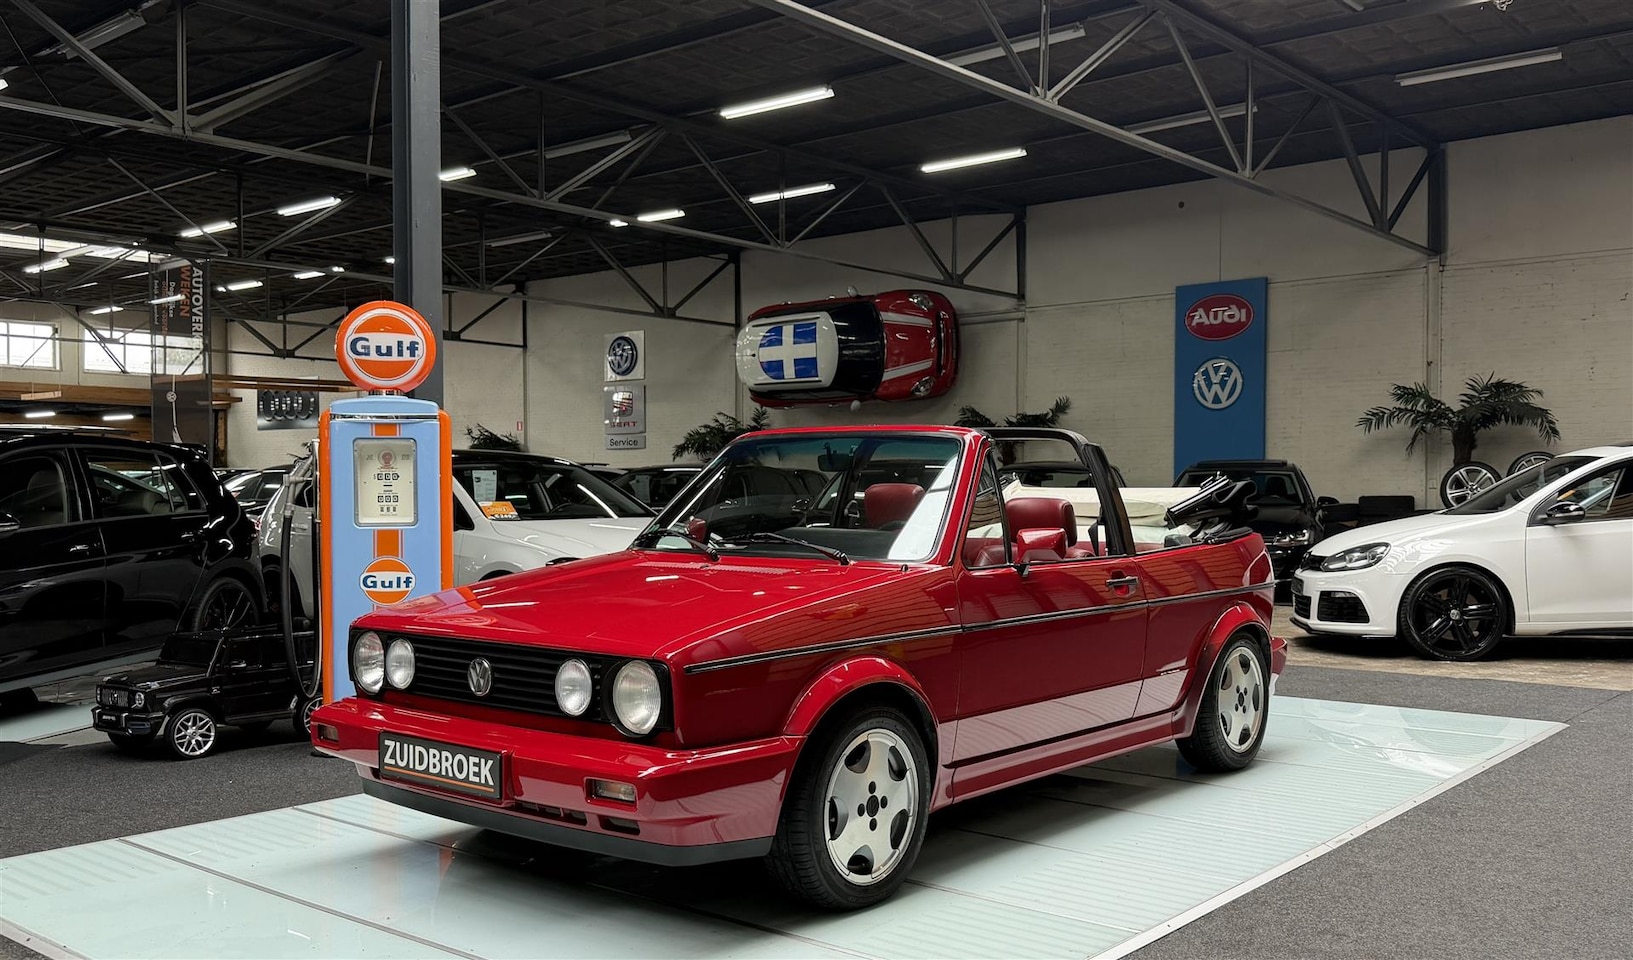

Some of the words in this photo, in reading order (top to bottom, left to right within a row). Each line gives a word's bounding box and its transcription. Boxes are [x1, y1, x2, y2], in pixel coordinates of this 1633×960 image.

[180, 266, 191, 318] WEKEN
[349, 336, 420, 358] Gulf
[609, 438, 639, 447] Service
[362, 575, 414, 589] Gulf
[383, 739, 495, 786] ZUIDBROEK
